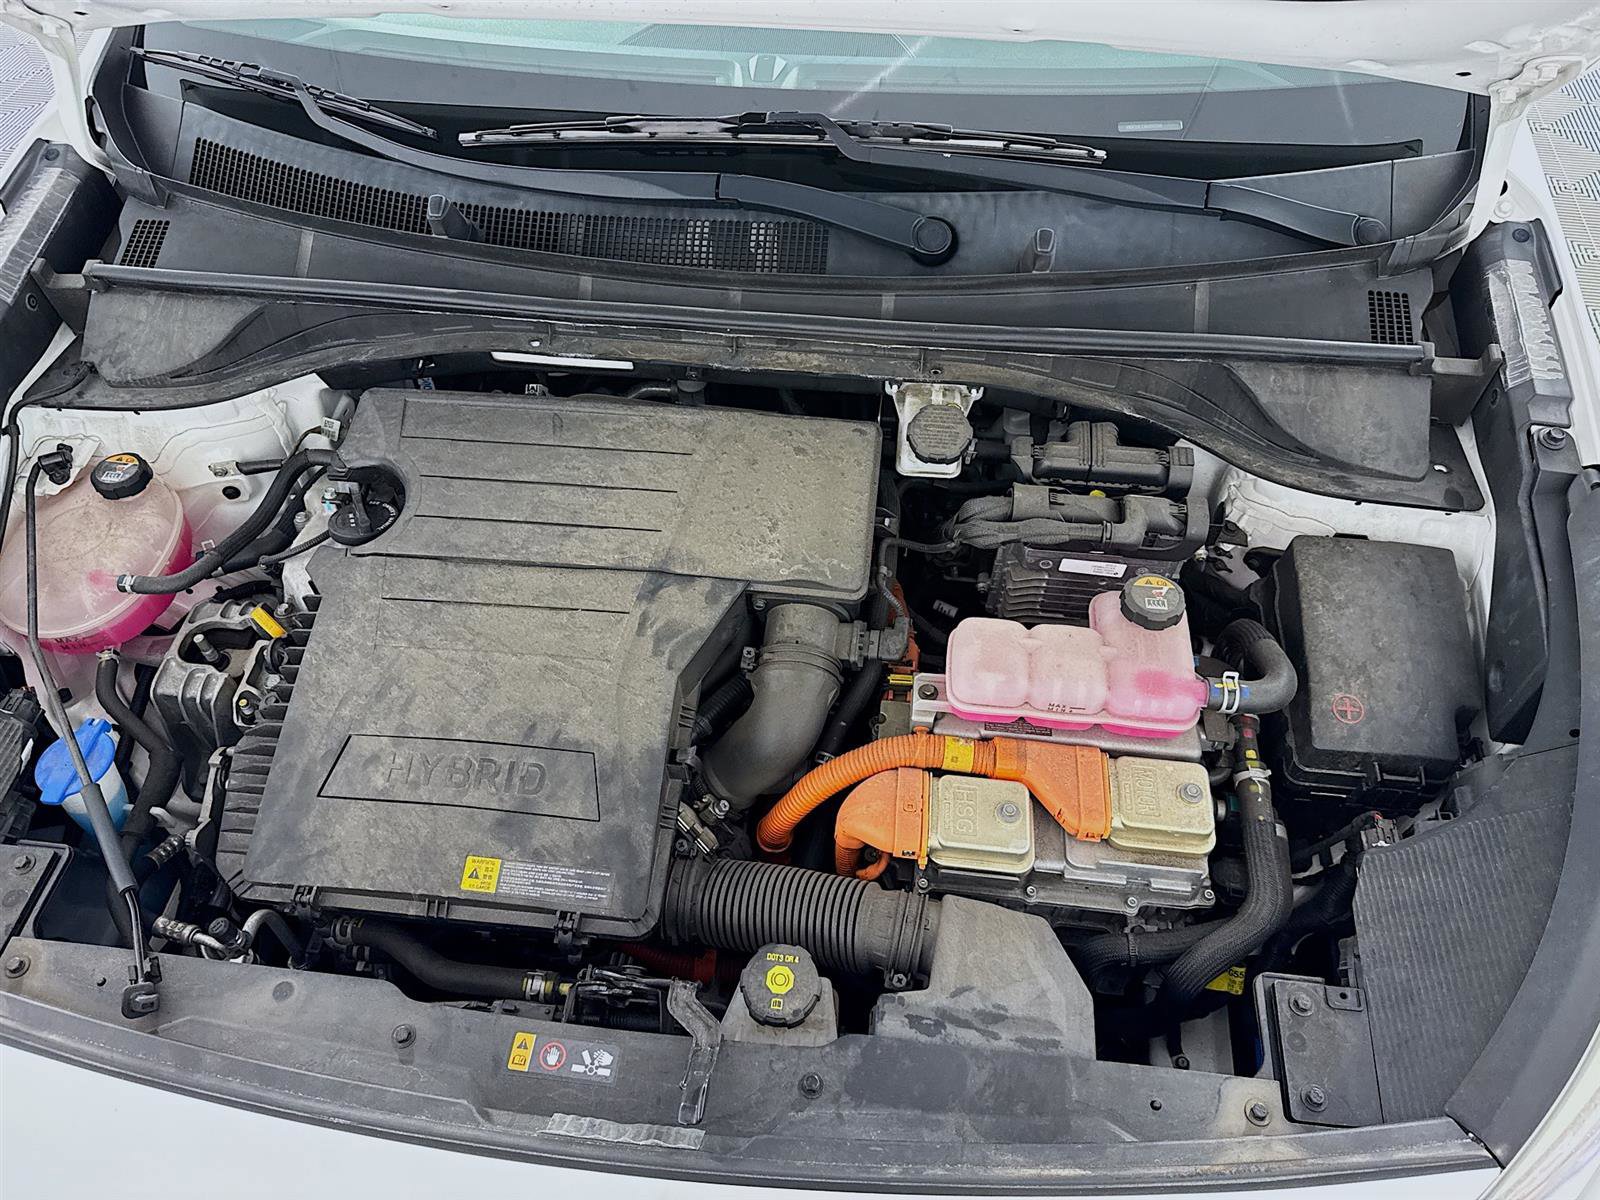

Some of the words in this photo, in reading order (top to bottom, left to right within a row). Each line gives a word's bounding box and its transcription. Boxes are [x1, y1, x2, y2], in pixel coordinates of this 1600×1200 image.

[385, 751, 548, 797] HYBRID
[1134, 766, 1156, 815] MOTOR
[953, 785, 977, 834] HSG
[766, 952, 784, 962] DOT3
[785, 954, 794, 963] OR
